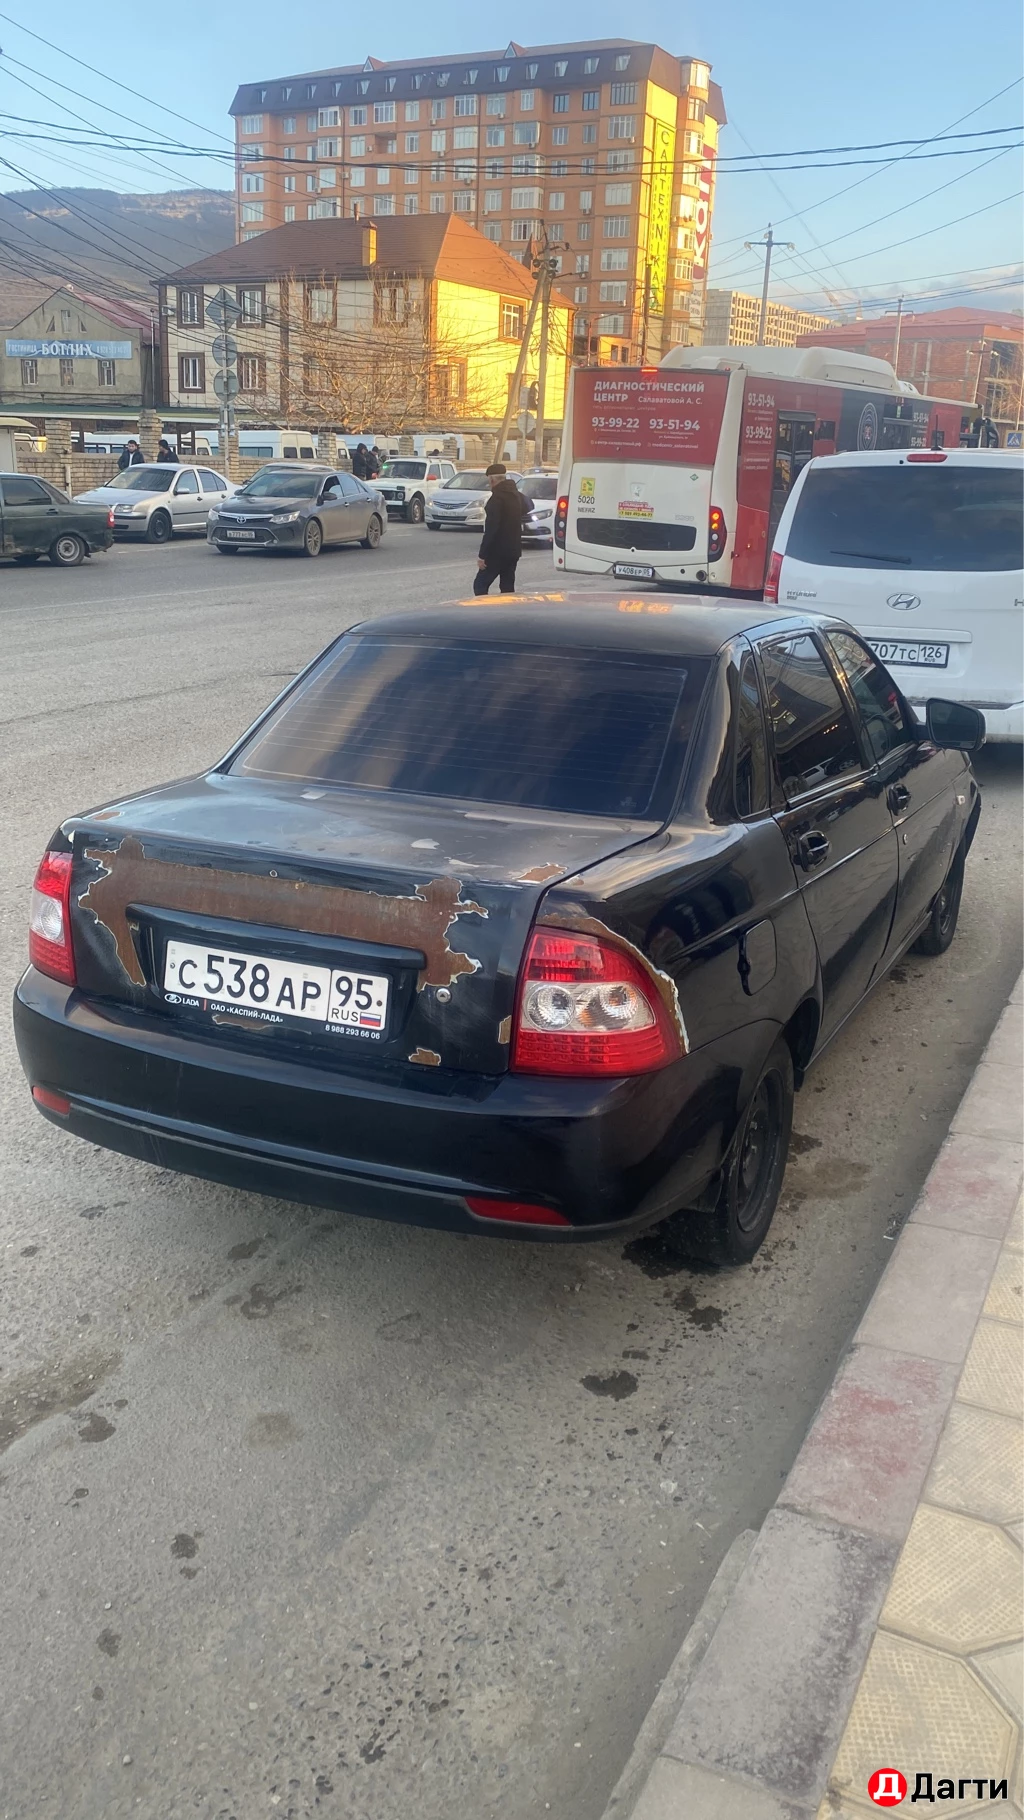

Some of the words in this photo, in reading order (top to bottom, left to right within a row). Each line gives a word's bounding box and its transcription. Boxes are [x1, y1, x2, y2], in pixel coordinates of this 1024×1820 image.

[41, 343, 94, 356] БОТЛИХ
[594, 381, 705, 393] ДИАГНОСТИЧЕСКИЙ
[593, 393, 628, 403] ЦЕНТР
[638, 396, 685, 405] Салаватовой
[747, 392, 775, 407] 93-51-94
[591, 416, 640, 428] 93-99-22
[649, 418, 701, 431] 93-51-94
[745, 425, 773, 439] 93-99-22
[577, 495, 595, 504] 5020
[920, 646, 943, 658] 126
[178, 954, 322, 1010] С538АР
[335, 976, 373, 1010] 95
[182, 997, 200, 1007] LADA
[210, 1003, 226, 1013] ОАО
[226, 1006, 284, 1023] «КАСПИЙ-ЛАДА»
[331, 1008, 359, 1022] RUS
[345, 1028, 359, 1036] 293
